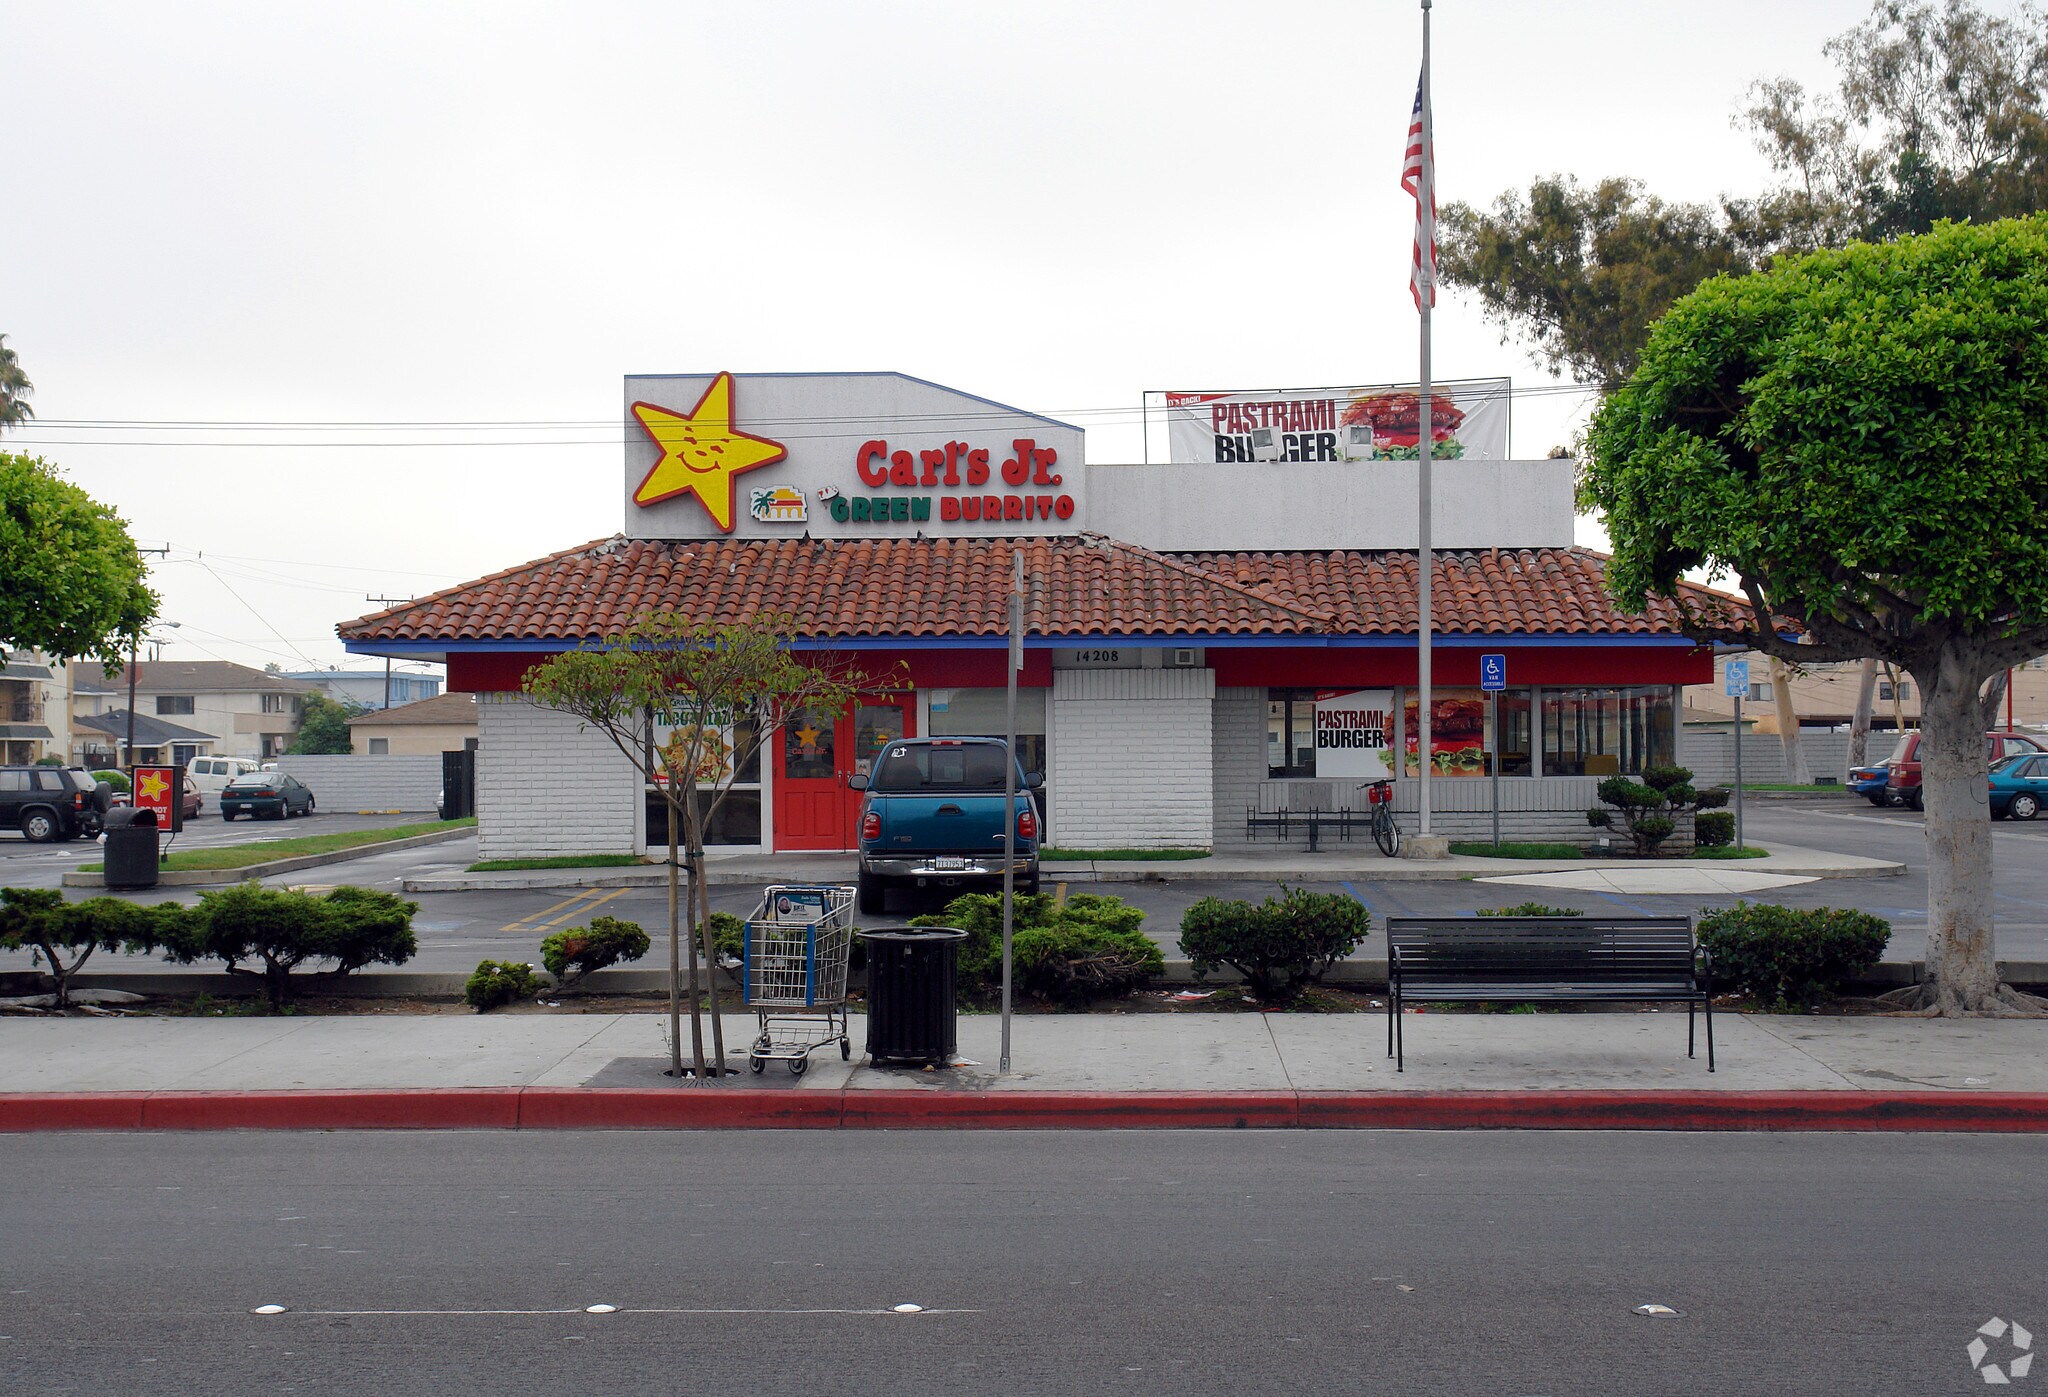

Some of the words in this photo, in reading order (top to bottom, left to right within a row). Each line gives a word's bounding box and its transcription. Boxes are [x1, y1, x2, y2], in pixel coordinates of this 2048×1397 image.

[1212, 399, 1336, 434] PASTRAMI
[1214, 432, 1338, 463] BUGER
[857, 440, 990, 487] Carl's
[1001, 439, 1063, 486] Jr.
[830, 496, 932, 523] GREEN
[940, 494, 1075, 521] BURRITO
[1076, 650, 1119, 662] 14208
[1318, 710, 1383, 729] PASTRAMI
[1318, 729, 1384, 748] BURGER
